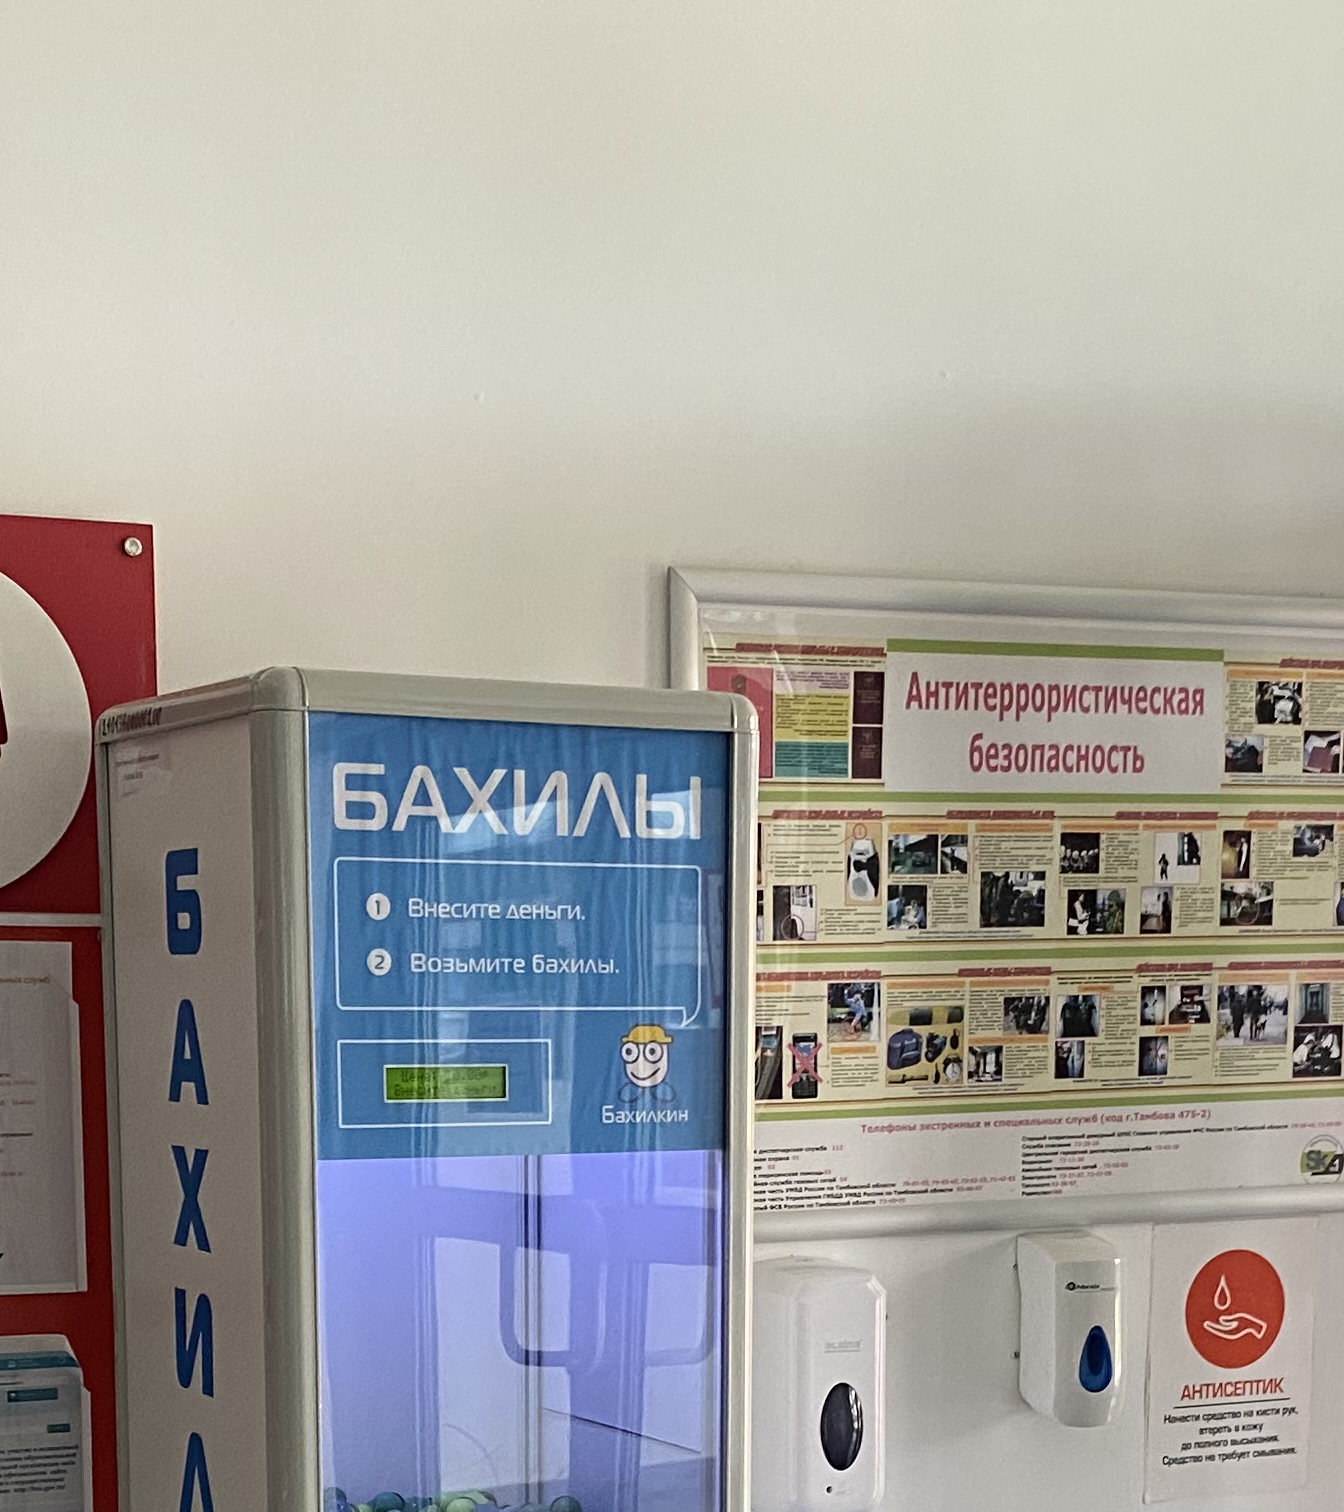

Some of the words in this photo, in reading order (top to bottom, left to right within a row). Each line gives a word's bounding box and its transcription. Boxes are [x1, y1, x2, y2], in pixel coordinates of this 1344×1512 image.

[905, 671, 1205, 722] Антитеррористическая
[969, 732, 1145, 774] безопасность
[332, 762, 701, 840] БАХИЛЫ
[408, 898, 501, 919] Внесите
[506, 902, 586, 921] деньги.
[410, 953, 525, 973] Возьмите
[532, 952, 620, 974] бахилы.
[601, 1105, 689, 1124] Бахилкин
[1066, 1114, 1098, 1126] служб
[1180, 1377, 1284, 1401] АНТИСЕПТИК
[1164, 1413, 1200, 1424] Нанести
[1202, 1410, 1242, 1423] средство
[1243, 1410, 1254, 1418] на
[1256, 1407, 1280, 1417] кисти
[1199, 1425, 1232, 1437] втереть
[1242, 1422, 1264, 1433] кожу
[1181, 1442, 1192, 1452] до
[1194, 1439, 1228, 1450] полного
[1162, 1454, 1203, 1468] Средство
[1218, 1449, 1250, 1463] требует
